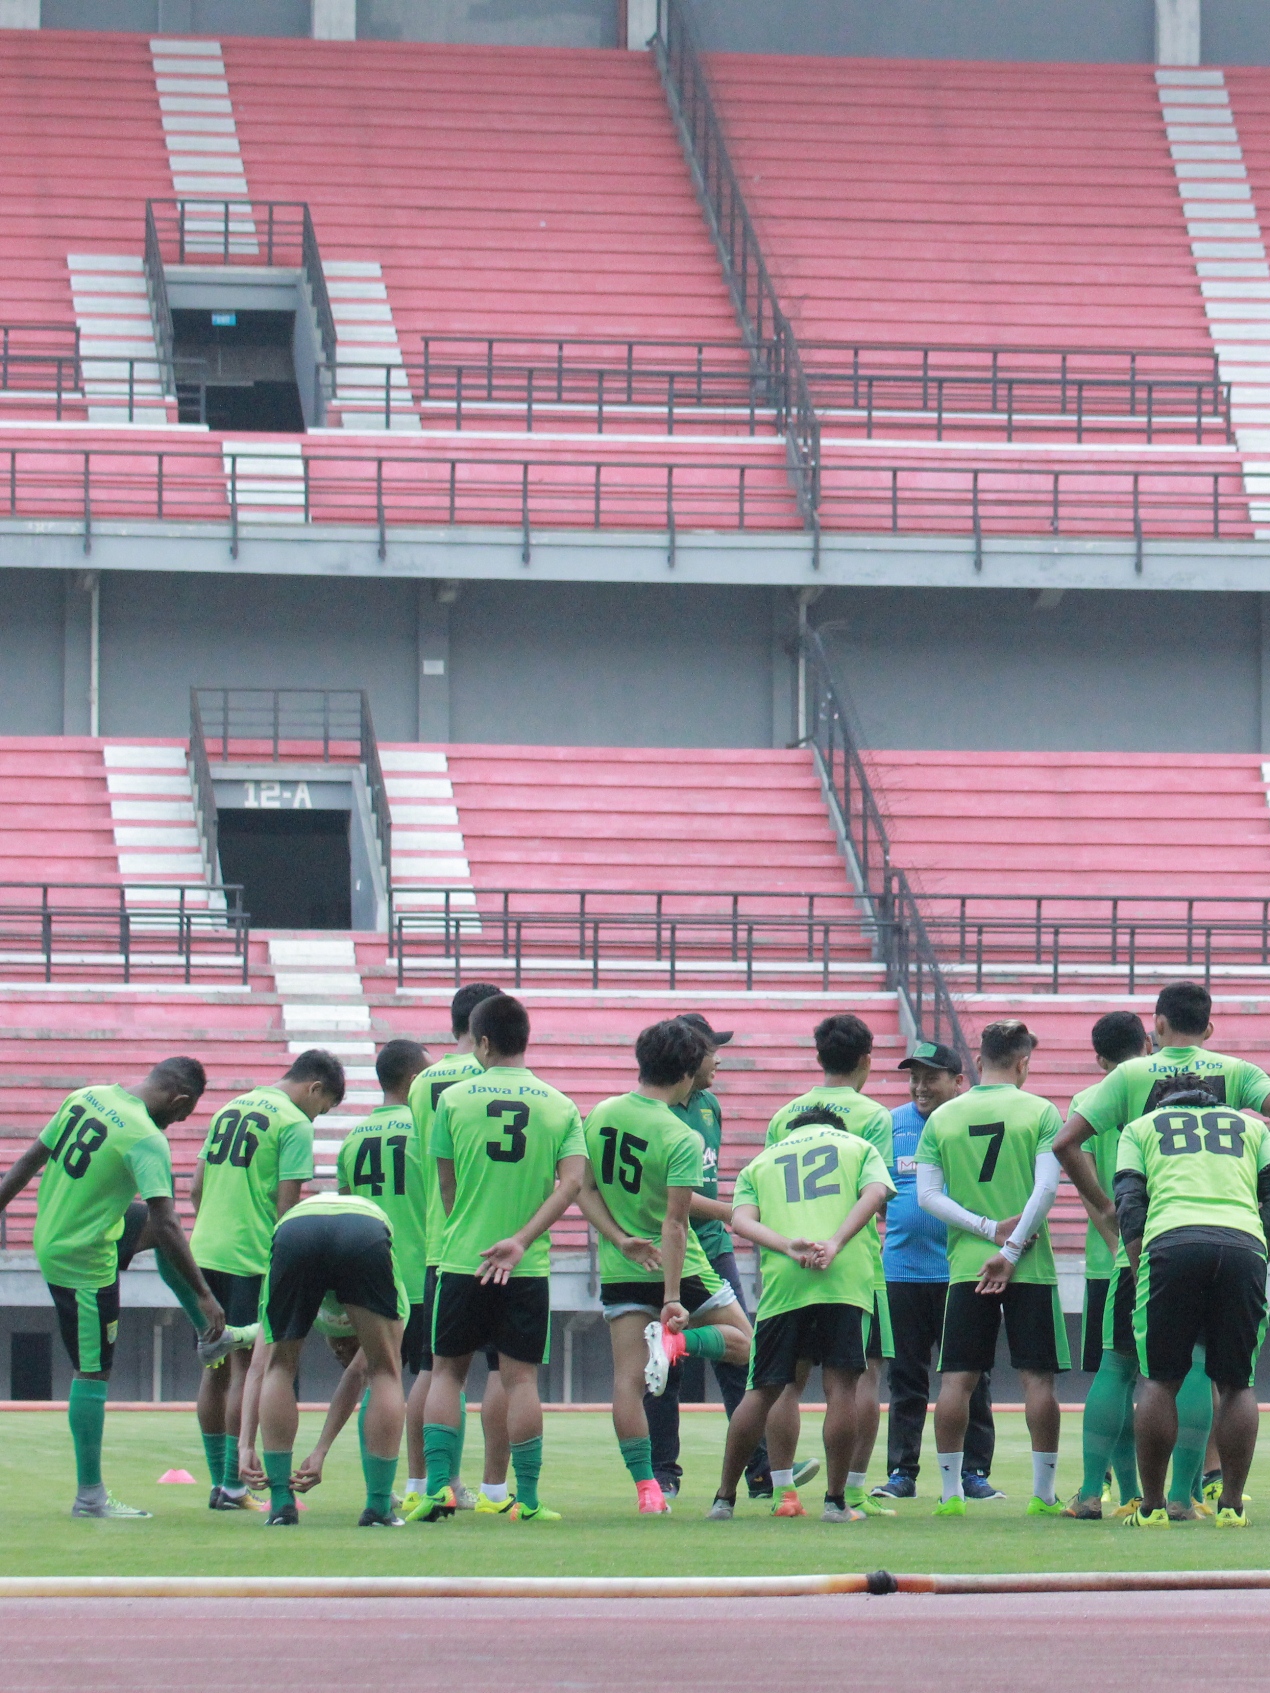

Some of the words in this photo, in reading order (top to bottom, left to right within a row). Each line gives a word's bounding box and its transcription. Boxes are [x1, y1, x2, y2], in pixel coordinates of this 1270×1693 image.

[244, 781, 313, 809] 12-A
[421, 1068, 457, 1079] Jawa
[461, 1064, 486, 1076] Po
[1148, 1062, 1189, 1073] Jawa
[1195, 1060, 1223, 1071] Pos
[81, 1089, 106, 1113] Jawa
[105, 1109, 127, 1129] Pos
[230, 1098, 255, 1107] awa
[257, 1099, 279, 1114] Pos
[468, 1084, 512, 1096] Jawa
[518, 1086, 549, 1098] Pos
[825, 1102, 852, 1114] Pos
[51, 1104, 108, 1180] 18
[206, 1109, 270, 1168] 96
[352, 1123, 383, 1136] Jawa
[387, 1120, 413, 1130] Pos
[486, 1099, 530, 1163] 3
[819, 1131, 850, 1140] Pos
[1153, 1111, 1246, 1158] 88
[353, 1135, 408, 1197] 41
[599, 1126, 649, 1195] 15
[968, 1121, 1005, 1182] 7
[774, 1144, 841, 1203] 12
